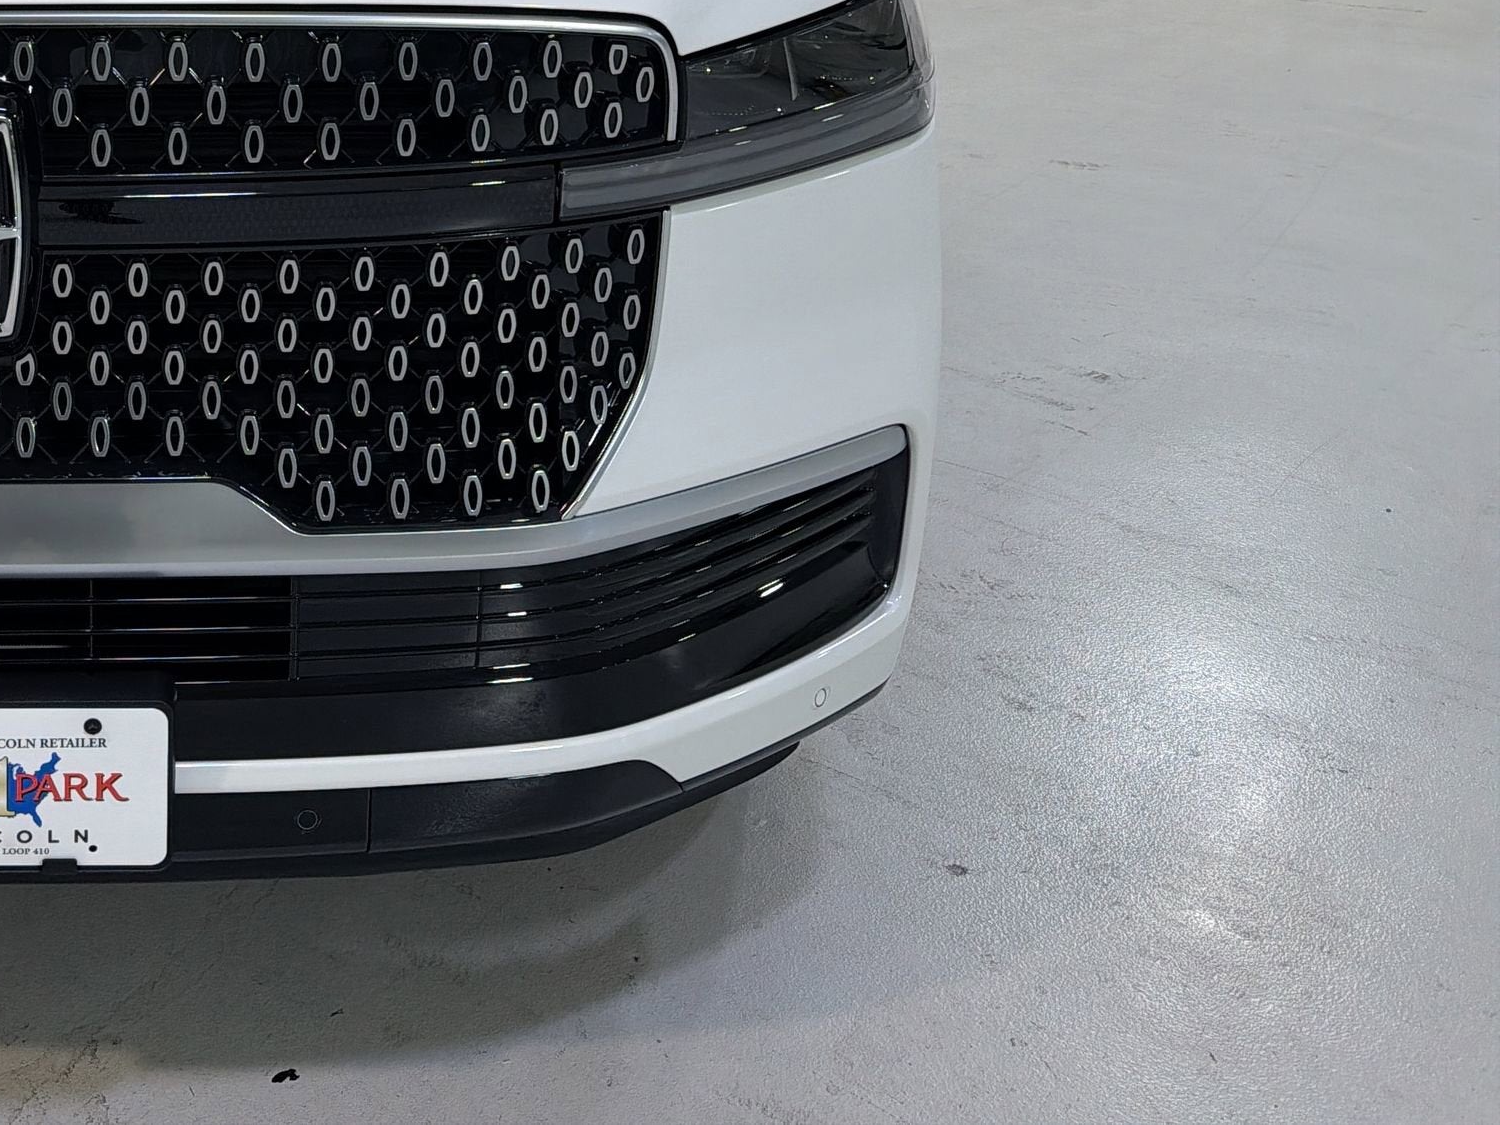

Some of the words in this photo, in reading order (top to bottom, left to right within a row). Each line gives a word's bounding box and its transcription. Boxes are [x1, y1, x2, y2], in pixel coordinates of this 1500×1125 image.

[40, 737, 108, 748] RETAILER
[14, 772, 130, 802] PARK
[3, 848, 31, 856] LOOP
[33, 847, 50, 856] 410
